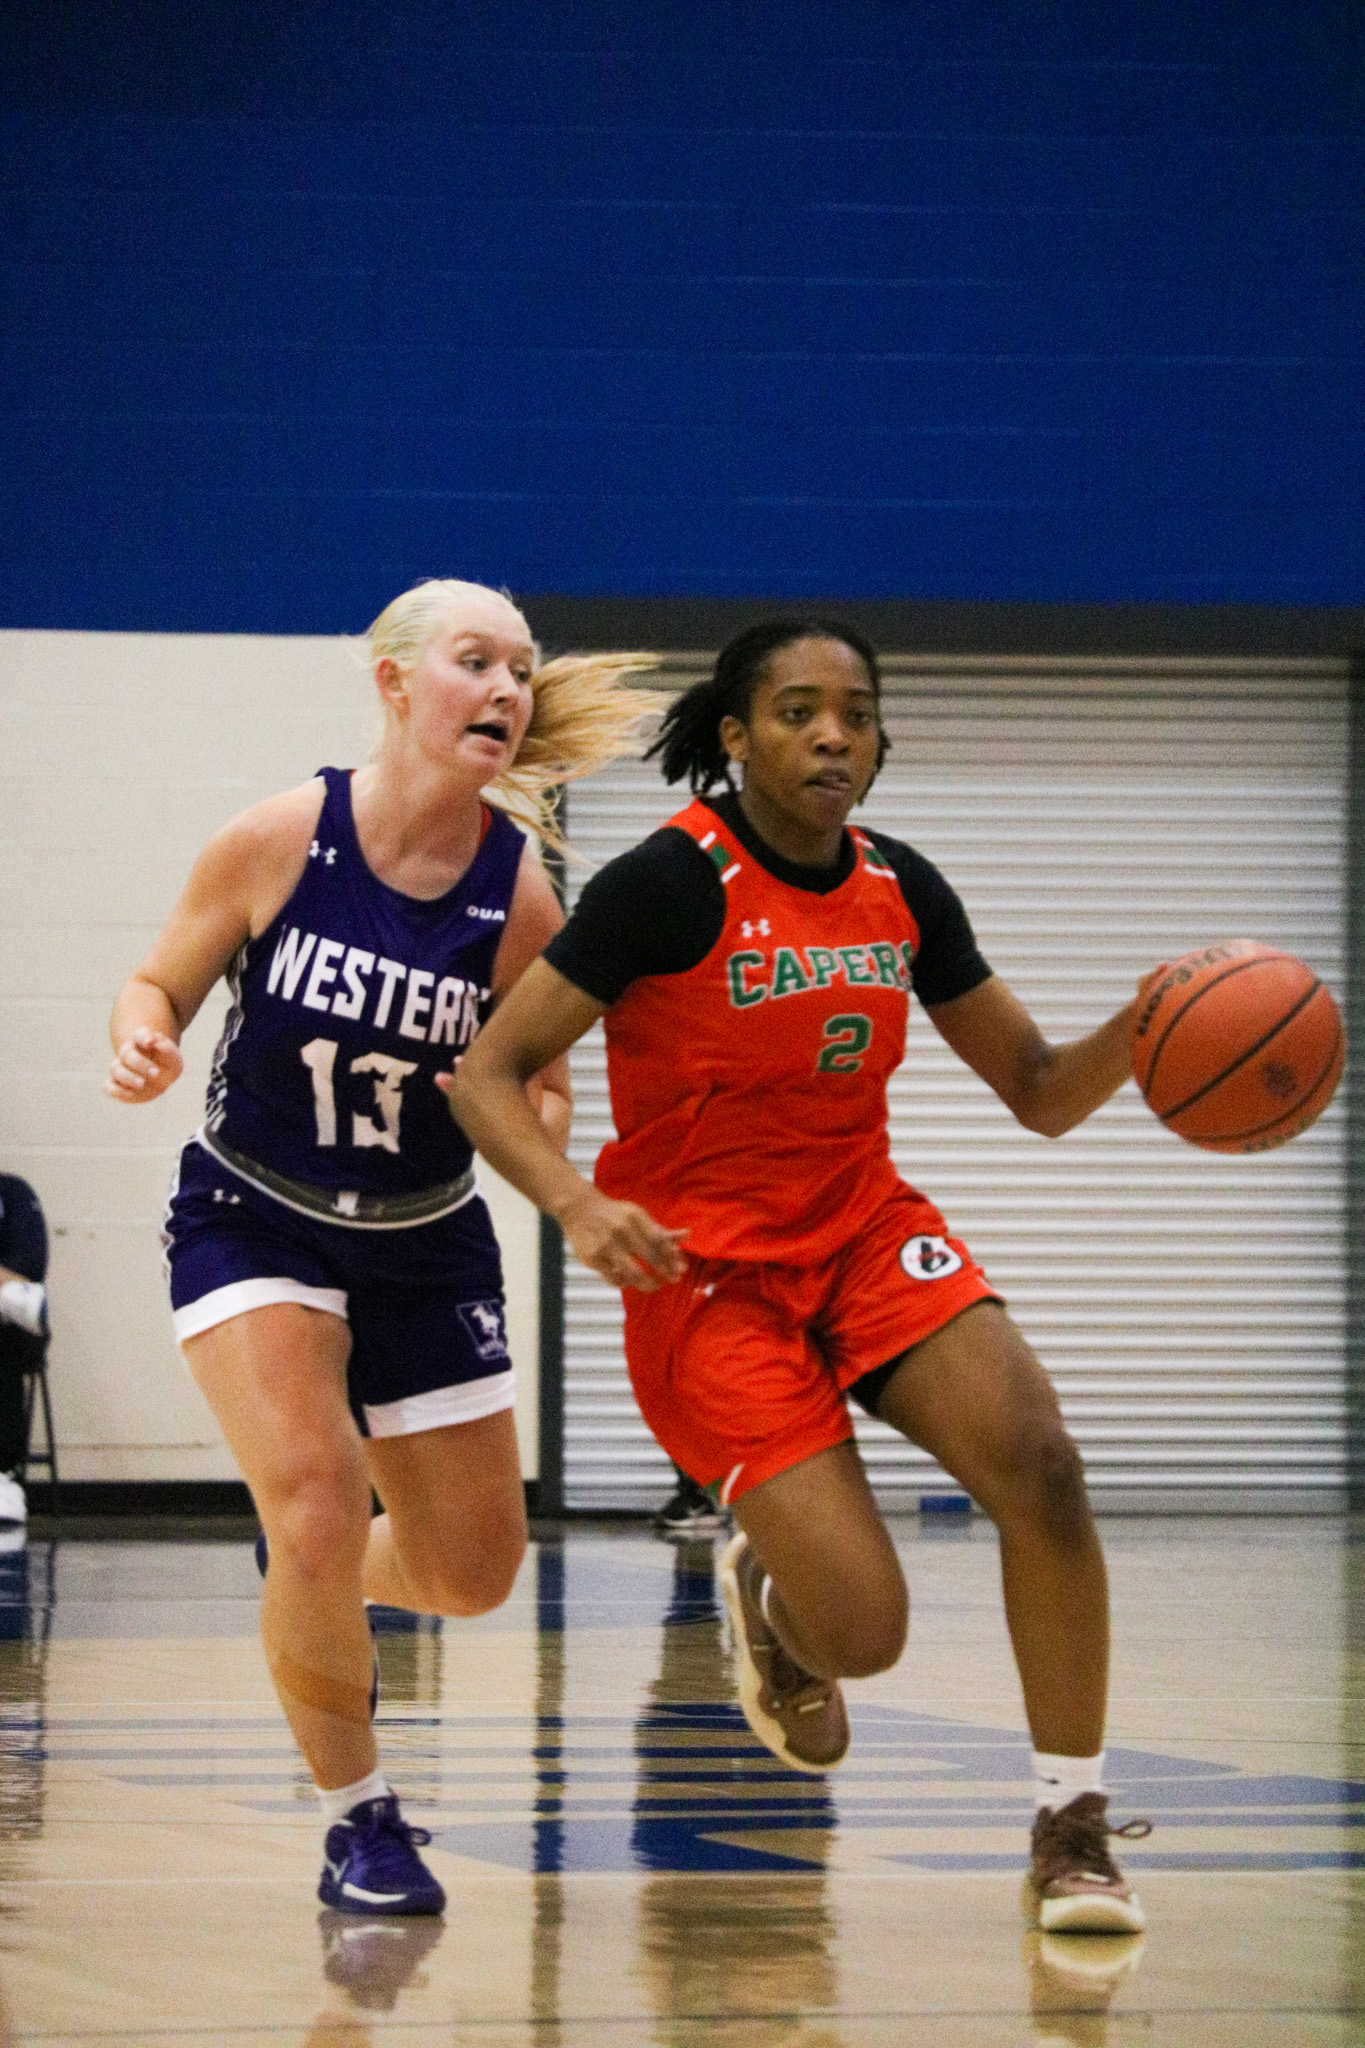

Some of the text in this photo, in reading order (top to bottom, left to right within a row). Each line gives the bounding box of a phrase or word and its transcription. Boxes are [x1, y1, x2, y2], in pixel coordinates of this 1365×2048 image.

[466, 904, 507, 922] OUA
[817, 1013, 874, 1074] 2
[300, 1037, 418, 1154] 13
